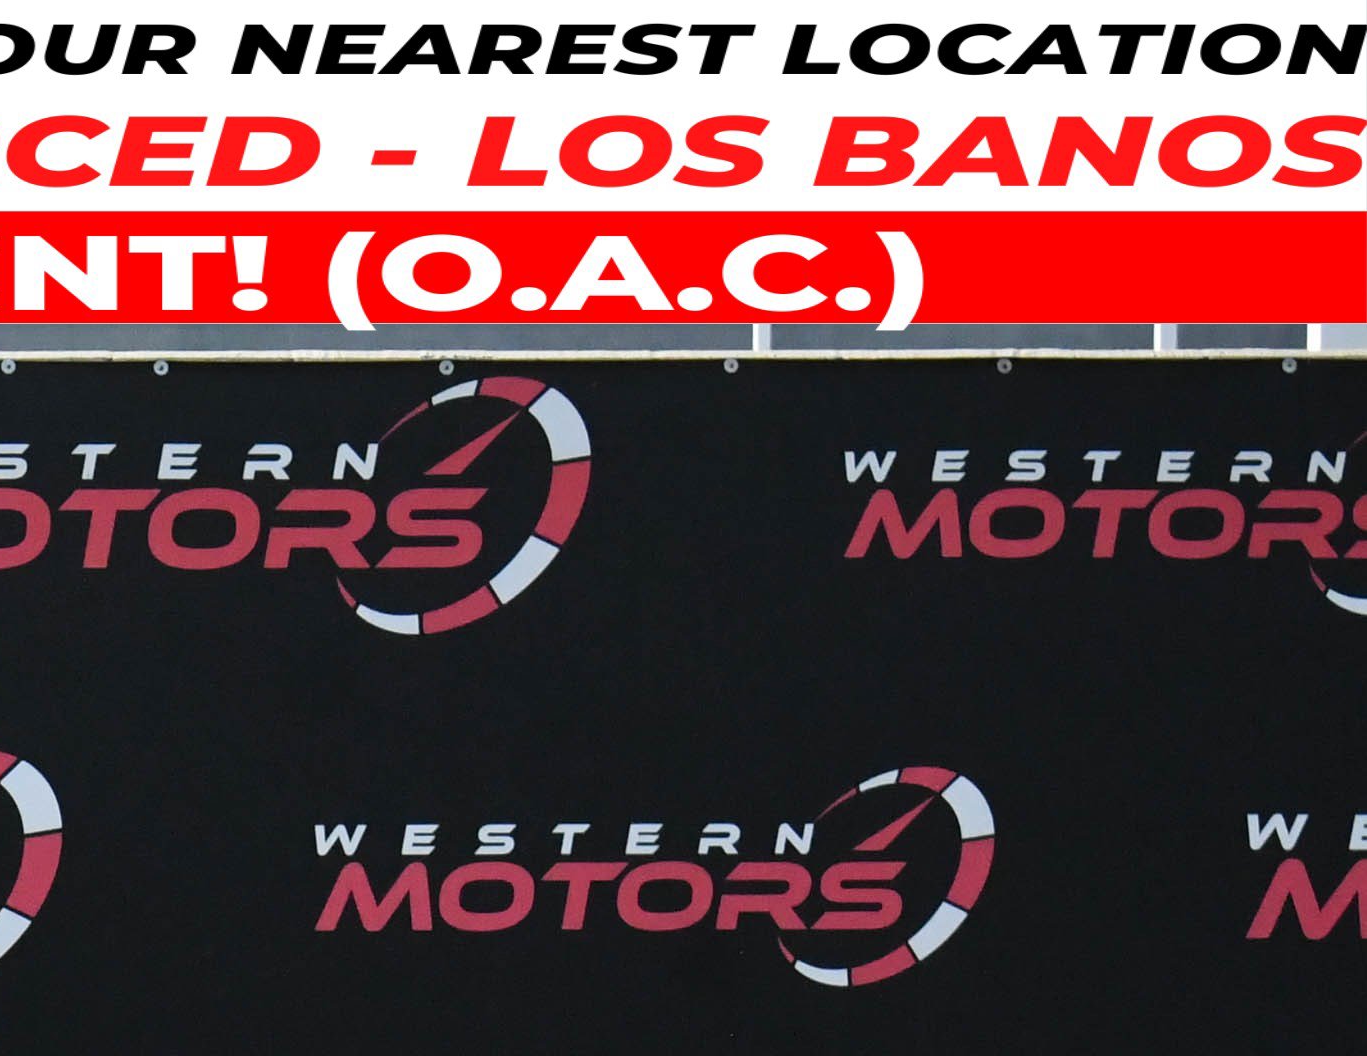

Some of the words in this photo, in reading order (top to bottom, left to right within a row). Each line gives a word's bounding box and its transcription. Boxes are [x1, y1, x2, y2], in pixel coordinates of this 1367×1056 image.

[844, 451, 1347, 482] WESTERN
[844, 488, 1367, 559] MOTOR
[314, 823, 815, 856] WESTERN
[315, 862, 906, 931] MOTORS
